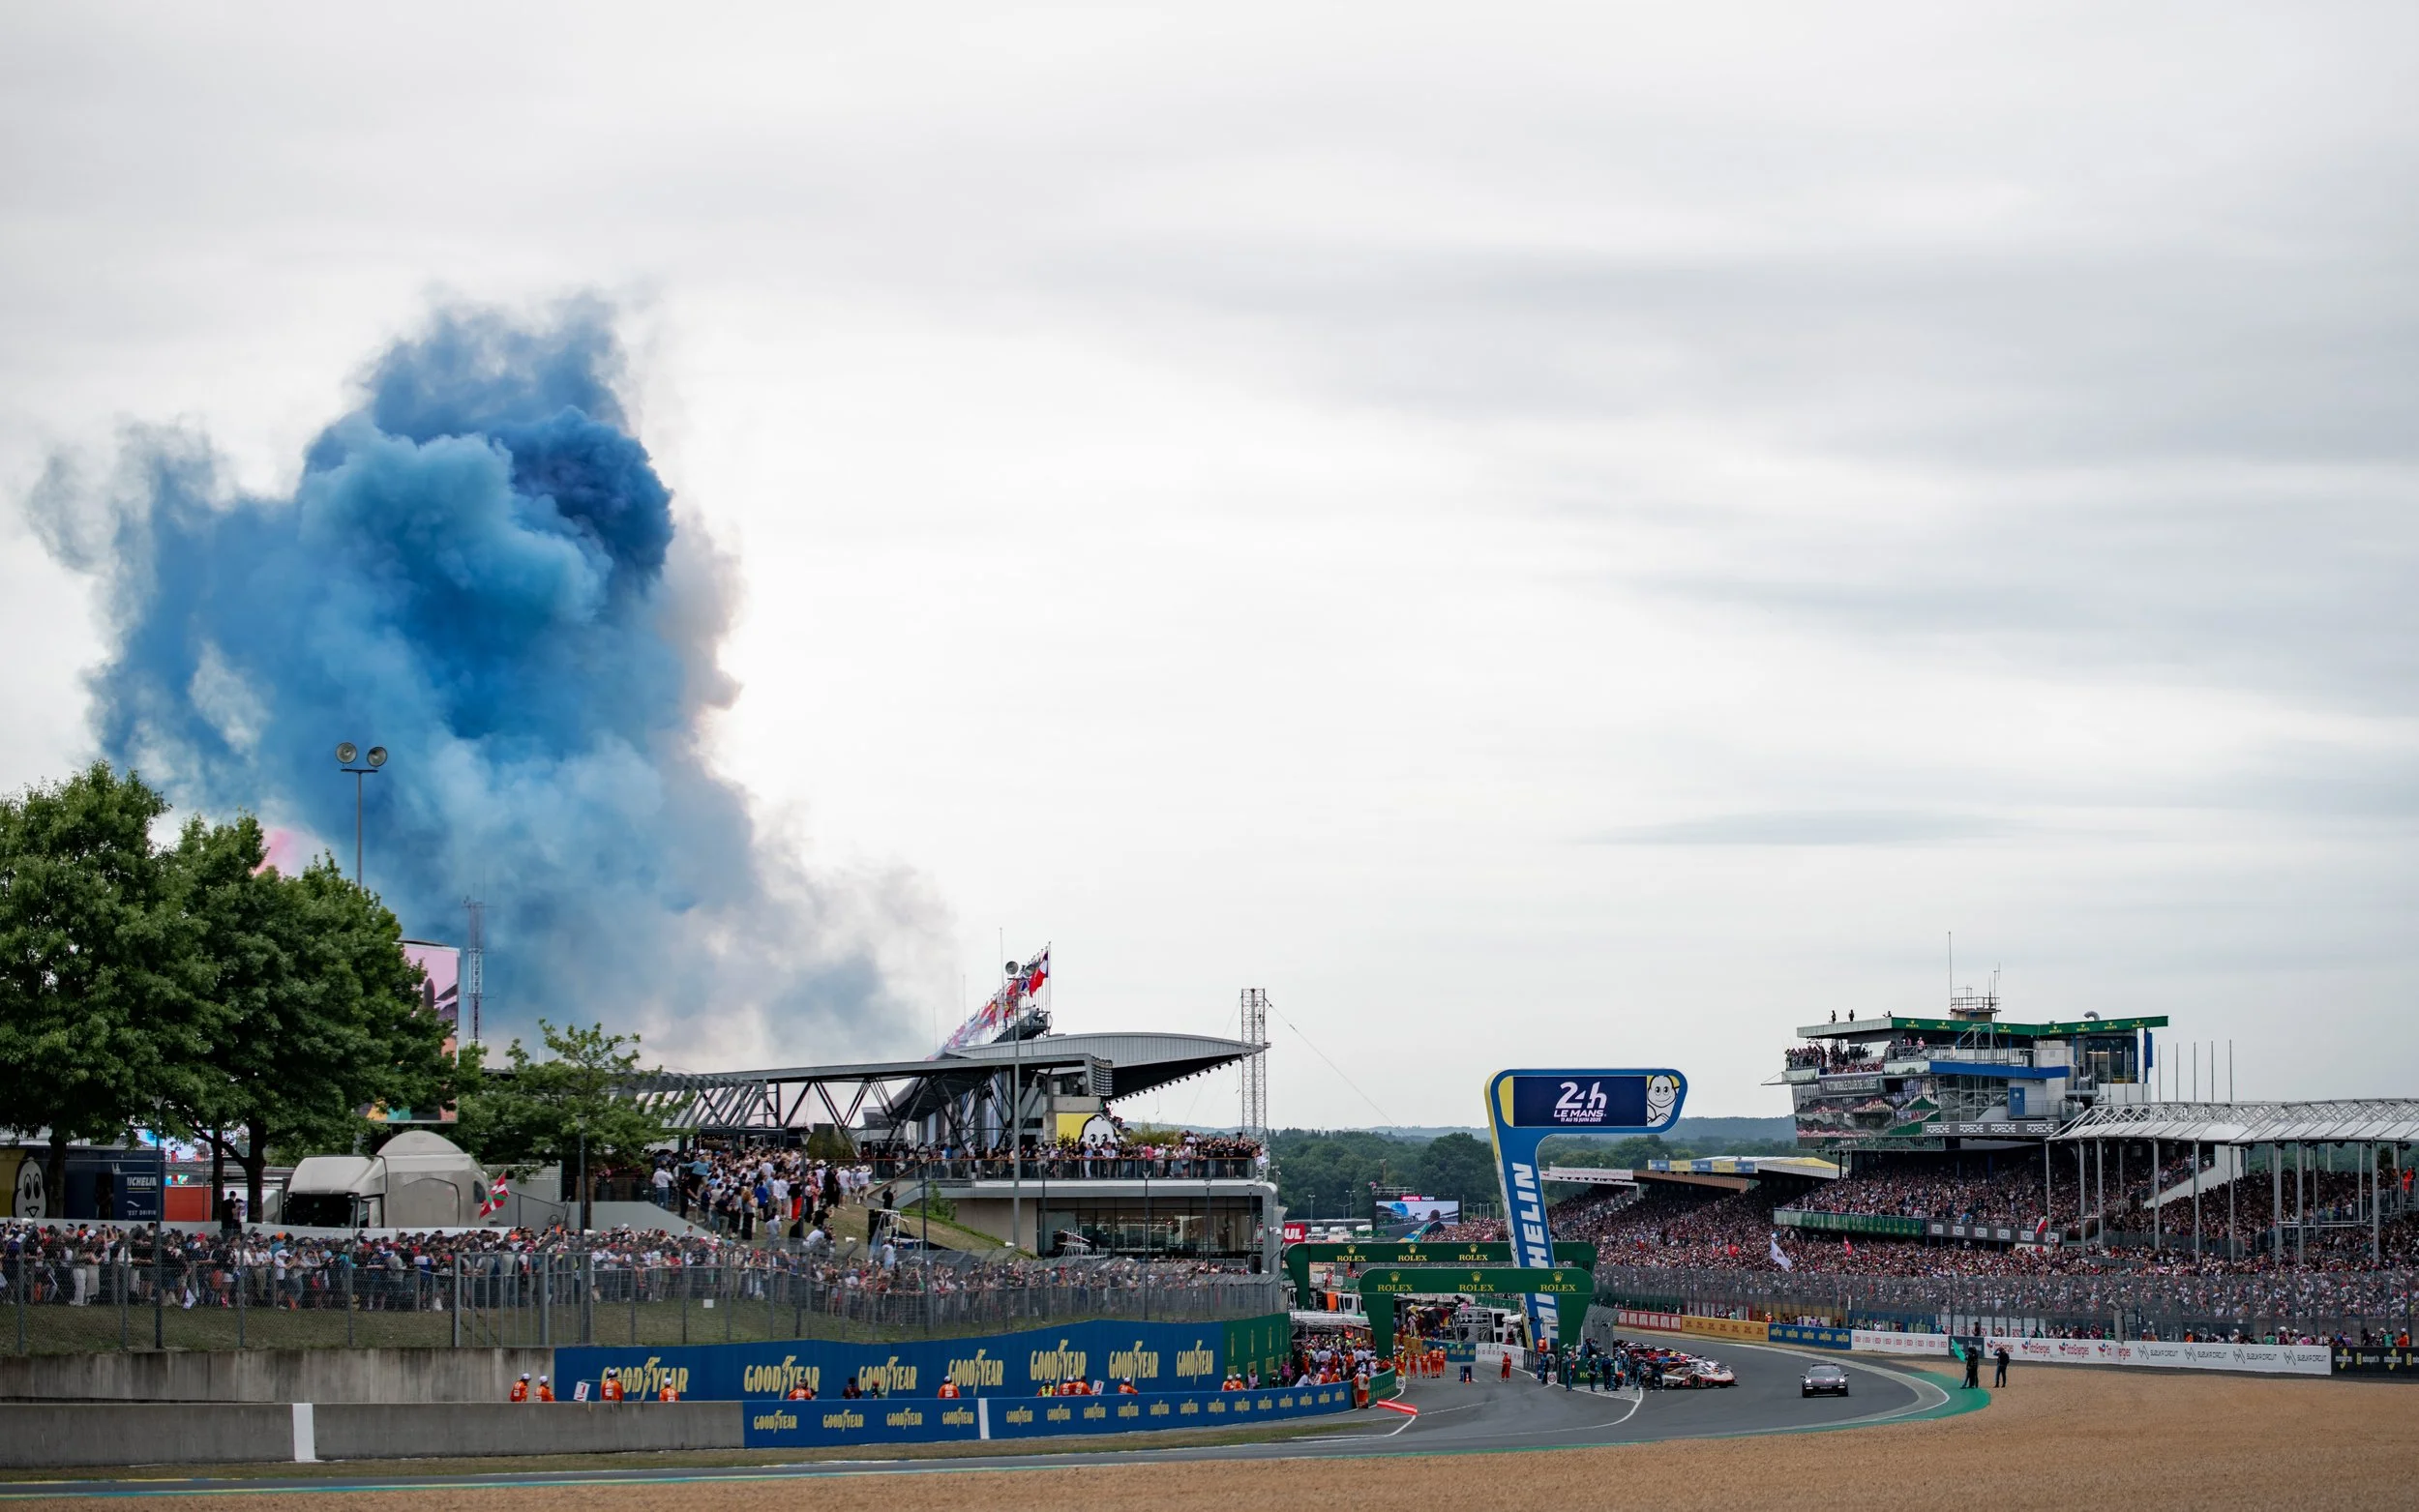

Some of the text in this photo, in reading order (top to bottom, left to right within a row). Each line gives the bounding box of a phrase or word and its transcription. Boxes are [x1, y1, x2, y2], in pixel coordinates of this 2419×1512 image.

[1554, 1081, 1607, 1109] 24h
[1570, 1109, 1604, 1117] MANS
[1926, 1125, 1950, 1134] PORSCHE
[1959, 1124, 1984, 1133] PORSCHE
[1991, 1124, 2016, 1133] PORSCHE
[2027, 1123, 2054, 1133] PORSCHE
[127, 1177, 157, 1186] ICHELIN
[1512, 1163, 1558, 1340] MIHELIN
[1030, 1348, 1087, 1382] GOODYEAR
[1109, 1349, 1159, 1380] GOODYEAR
[1177, 1347, 1214, 1379] GOODYEAR
[948, 1356, 1003, 1387] GOODYEAR
[754, 1413, 797, 1431] GOODYEAR
[823, 1413, 864, 1429] GOODYEAR
[887, 1411, 923, 1427] GOODYEAR
[942, 1410, 974, 1425] GOODYEAR
